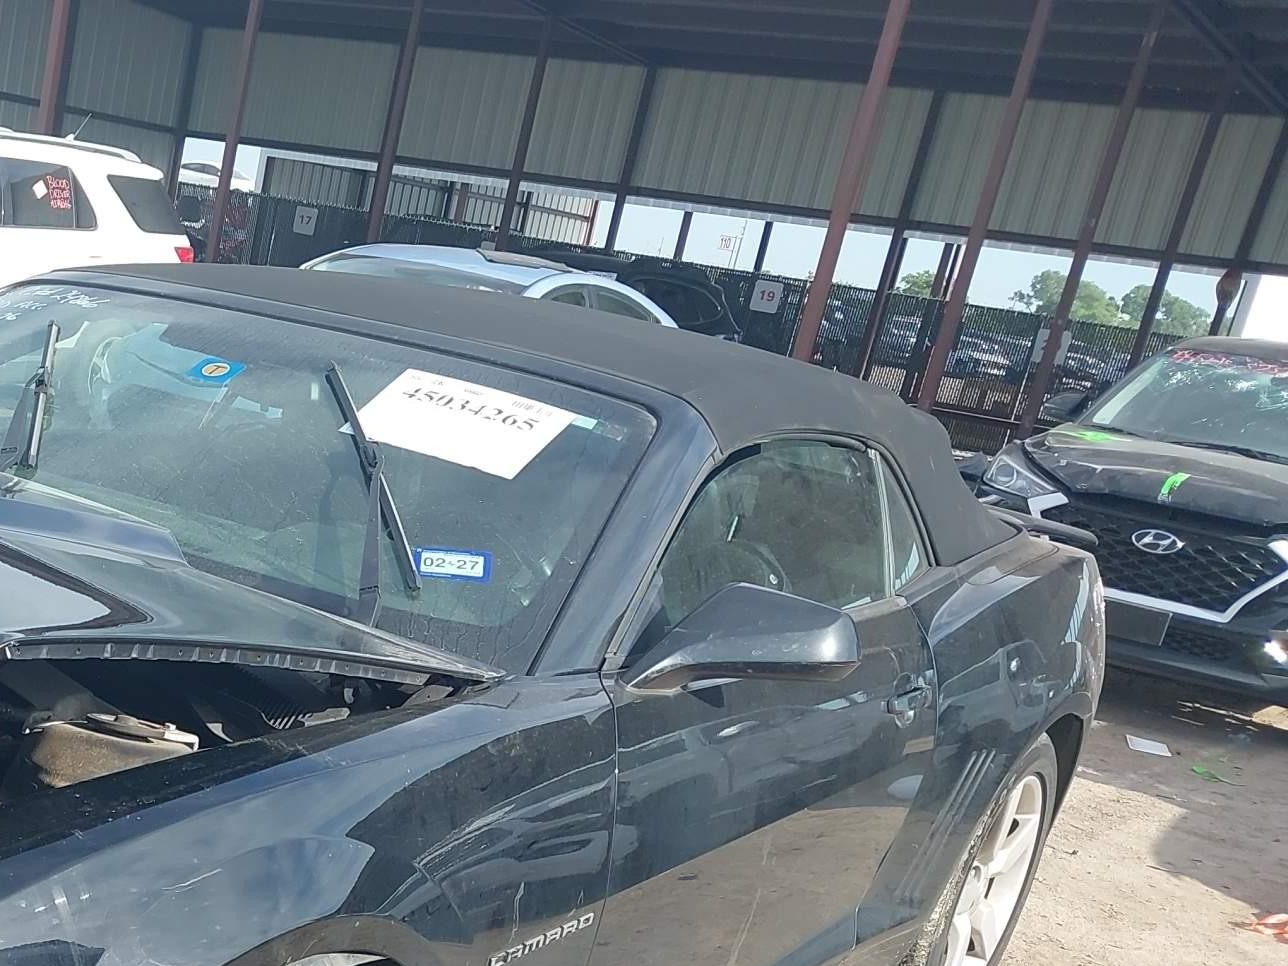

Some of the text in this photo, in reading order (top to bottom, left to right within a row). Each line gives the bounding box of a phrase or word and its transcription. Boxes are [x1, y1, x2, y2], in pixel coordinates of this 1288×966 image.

[299, 215, 312, 225] 17
[759, 289, 775, 302] 19
[402, 387, 540, 431] 45034265
